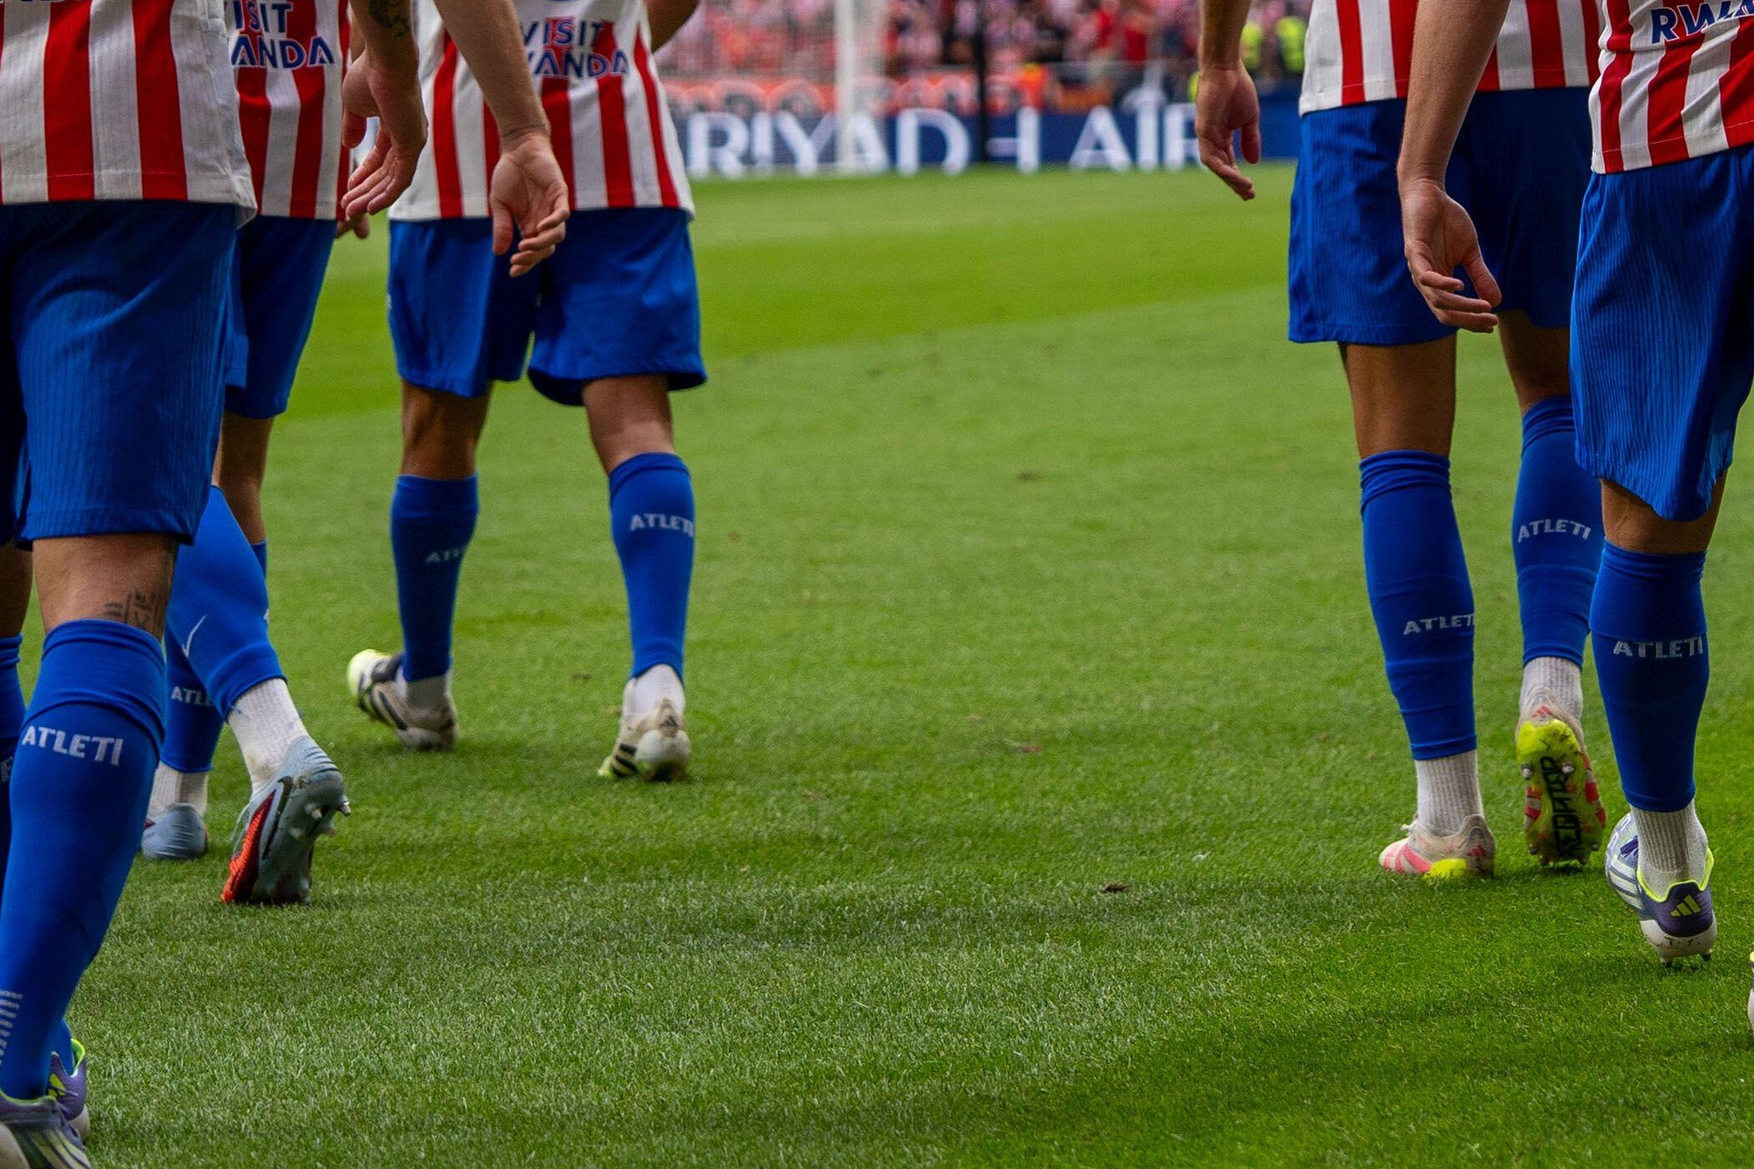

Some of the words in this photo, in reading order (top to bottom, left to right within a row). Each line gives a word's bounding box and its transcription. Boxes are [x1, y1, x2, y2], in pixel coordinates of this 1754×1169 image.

[224, 0, 293, 33] ISIT
[228, 35, 335, 69] ANDA
[528, 48, 630, 78] ANDA
[687, 109, 1040, 176] RIYADH
[1517, 518, 1592, 544] ATLETI
[1612, 635, 1704, 660] ATLETI
[21, 725, 124, 767] ATLETI
